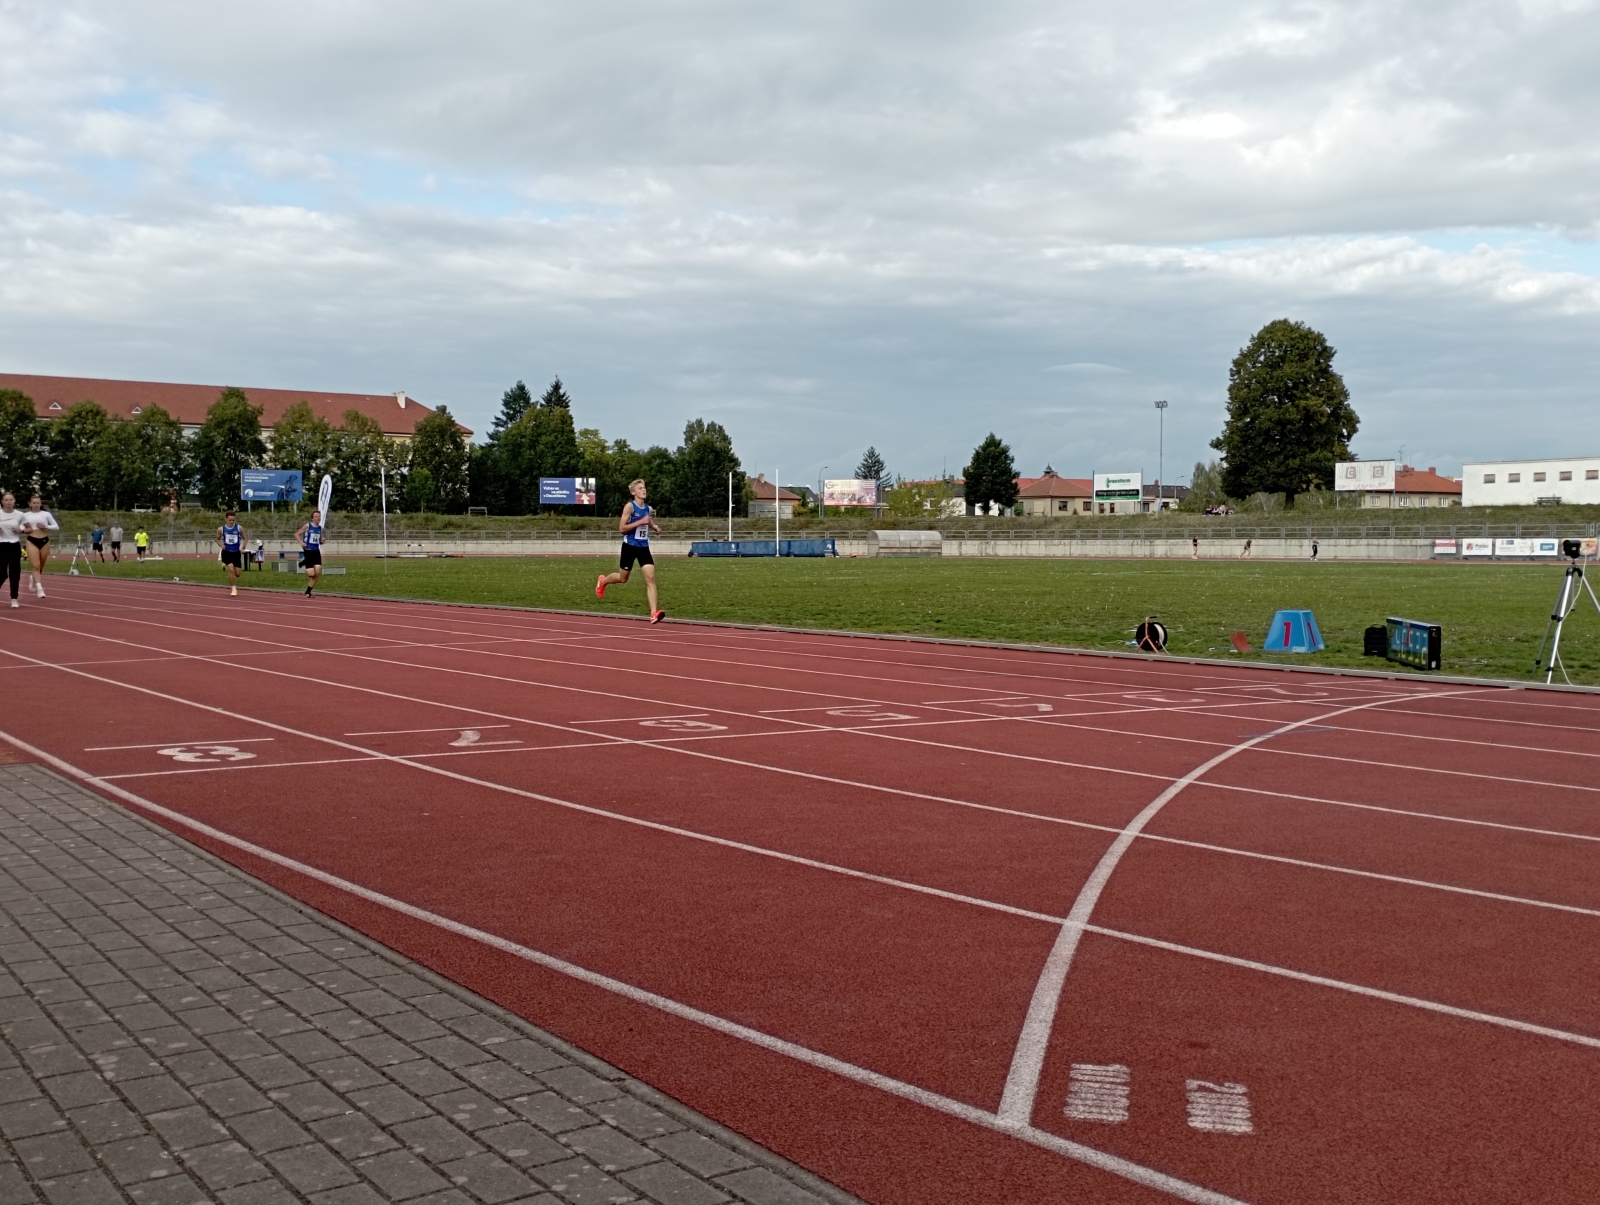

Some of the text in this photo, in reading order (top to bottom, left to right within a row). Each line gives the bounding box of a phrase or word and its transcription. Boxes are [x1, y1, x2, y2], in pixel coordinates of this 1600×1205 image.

[639, 530, 646, 538] 15
[1283, 621, 1292, 647] 1
[1306, 622, 1317, 647] 1
